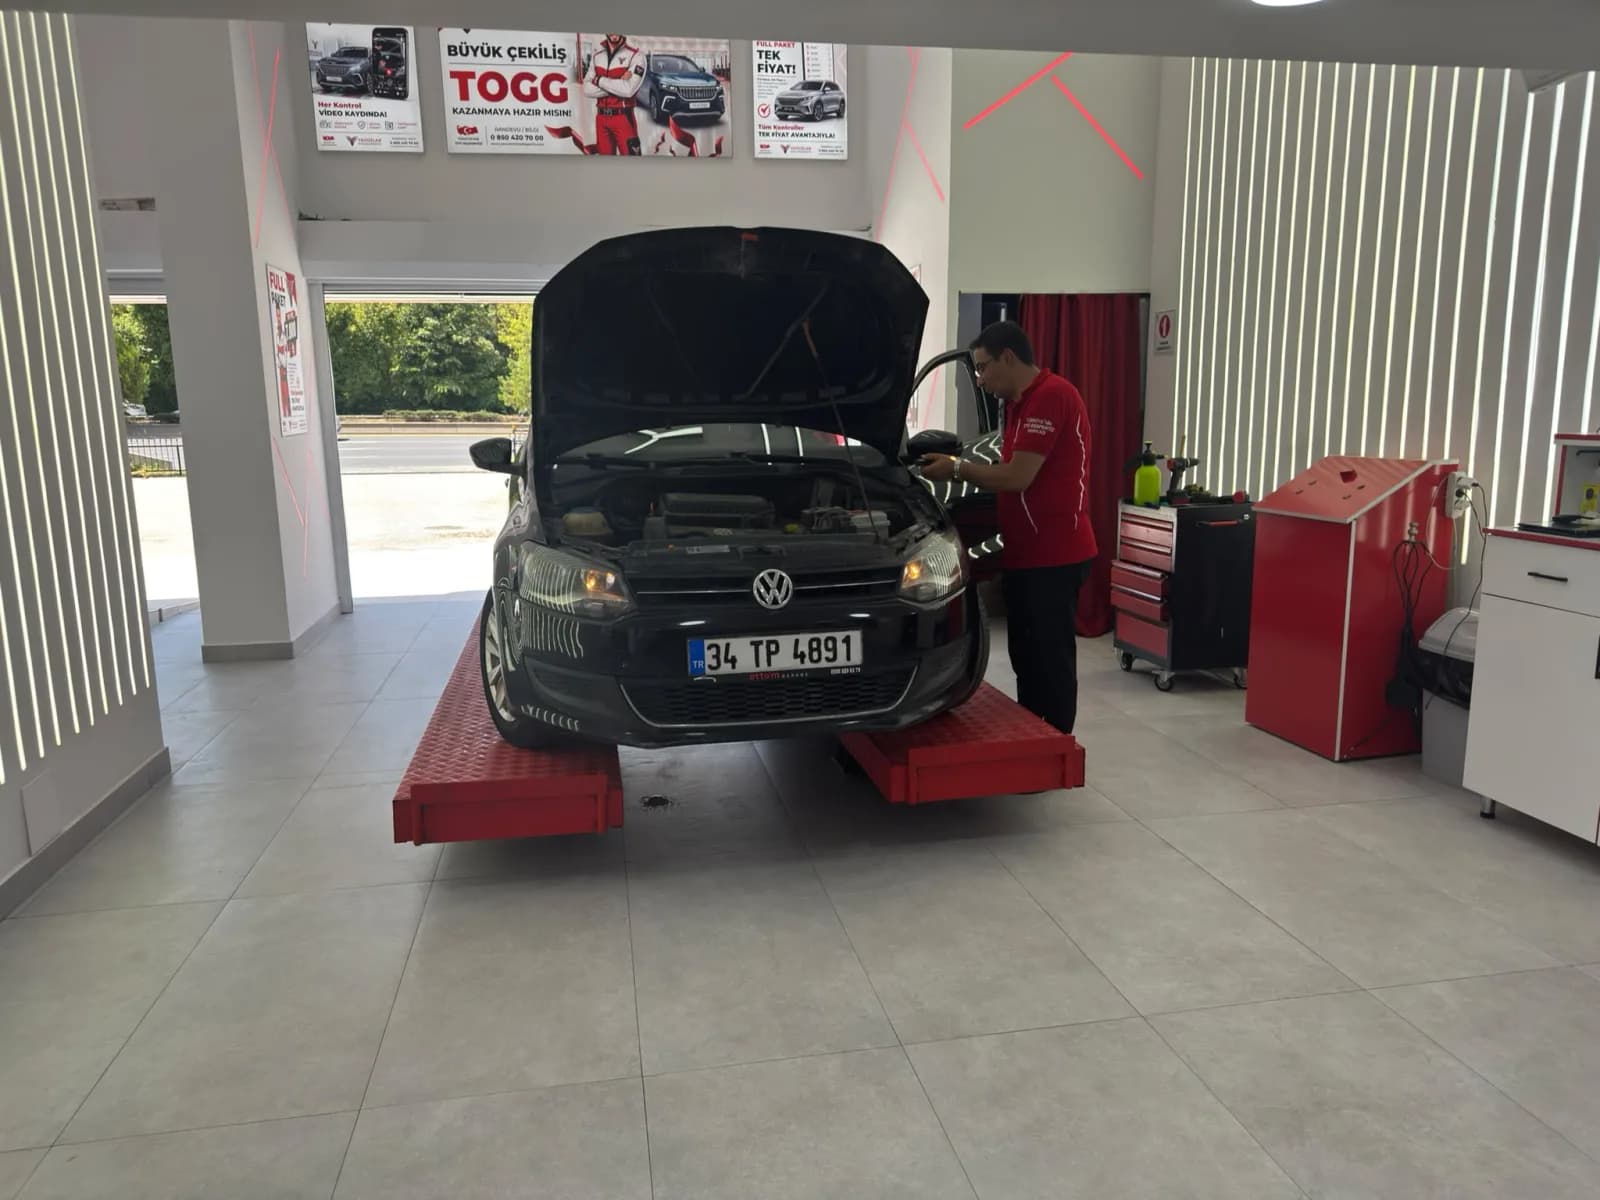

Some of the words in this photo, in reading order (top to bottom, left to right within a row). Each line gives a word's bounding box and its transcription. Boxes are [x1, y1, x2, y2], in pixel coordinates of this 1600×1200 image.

[447, 41, 503, 58] BÜYÜK
[507, 43, 567, 63] ÇEKİLİŞ
[757, 50, 781, 60] TEK
[757, 61, 796, 74] FİYAT!
[449, 71, 569, 104] TOGG
[319, 109, 343, 117] VİDEO
[345, 110, 387, 118] KAYDINDA!
[452, 107, 511, 116] KAZANMAYA
[513, 108, 541, 116] HAZIR
[543, 109, 572, 117] MISIN!
[269, 271, 285, 293] FULL
[692, 660, 704, 668] TR
[707, 642, 738, 671] 34
[750, 639, 780, 668] TP
[792, 634, 852, 665] 4891
